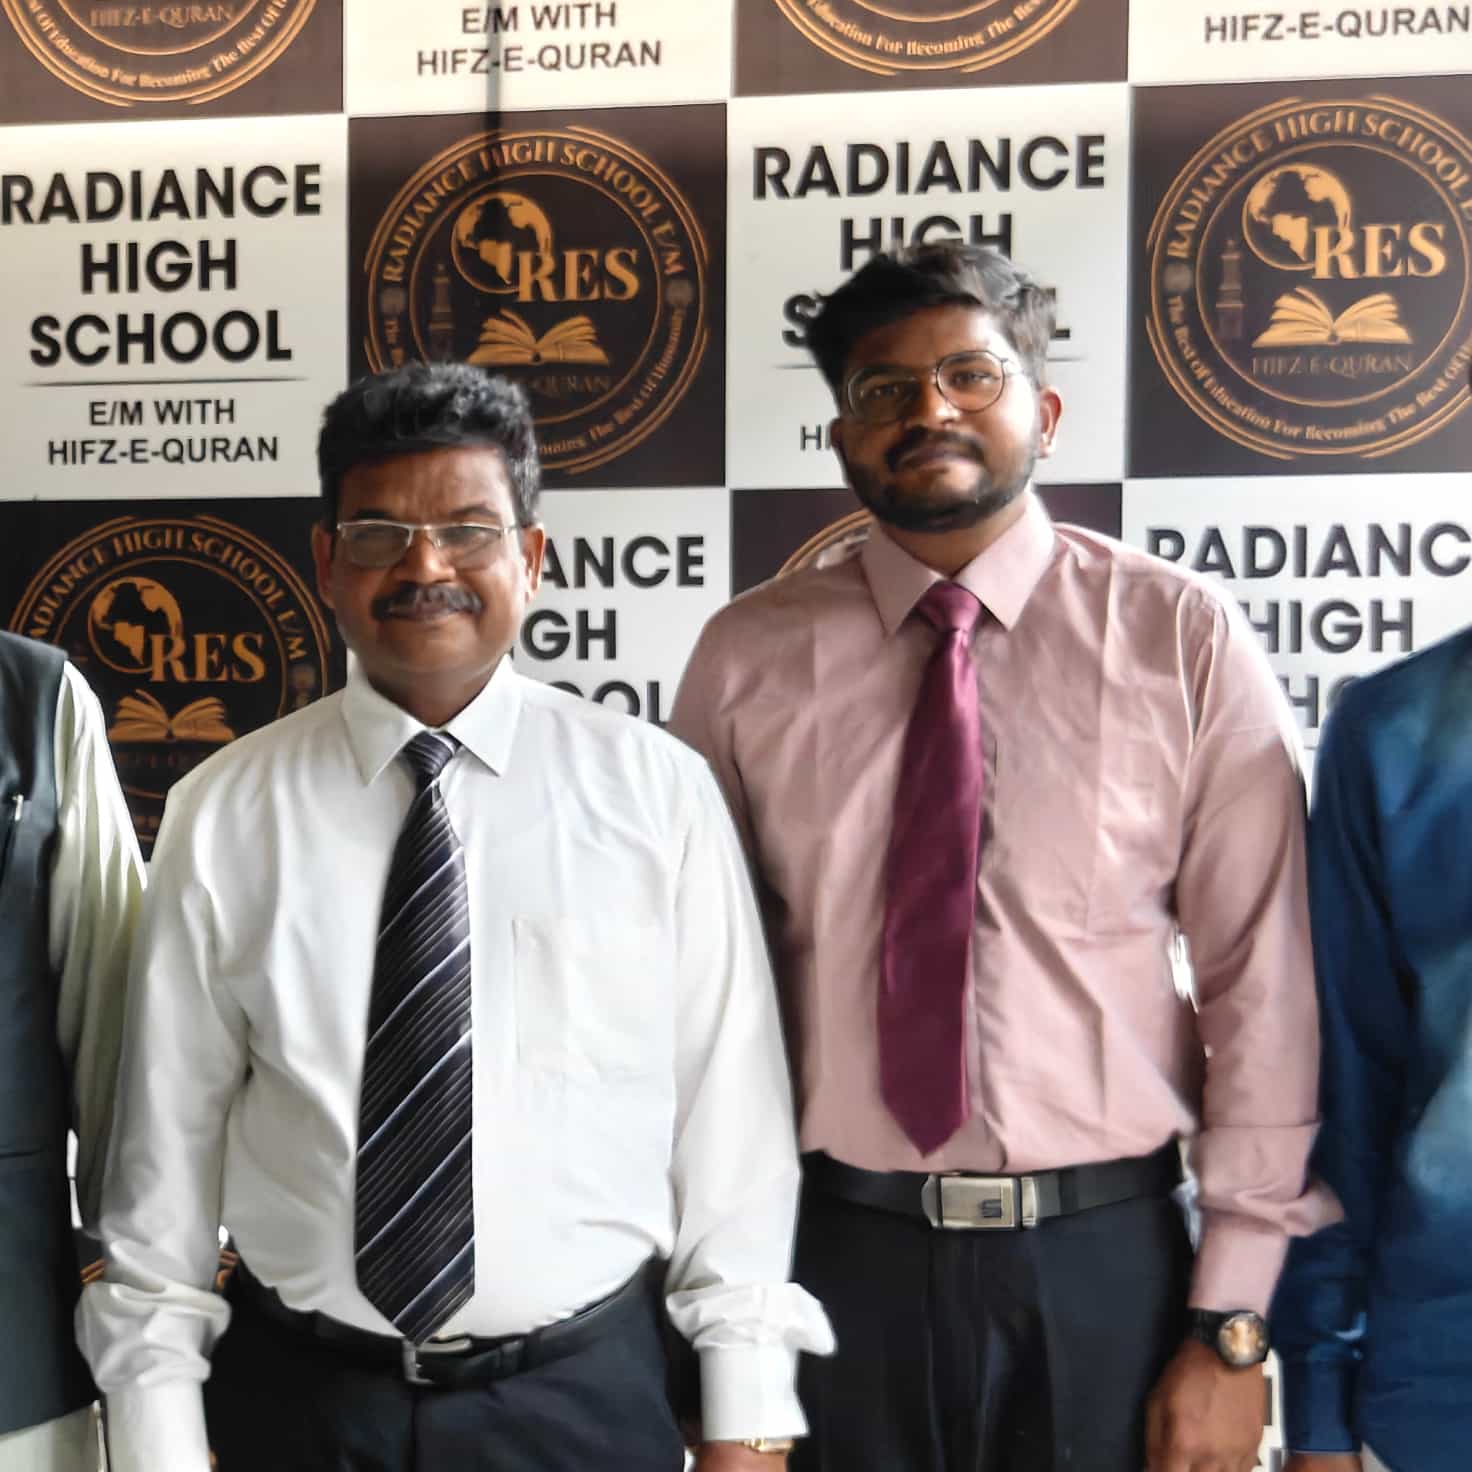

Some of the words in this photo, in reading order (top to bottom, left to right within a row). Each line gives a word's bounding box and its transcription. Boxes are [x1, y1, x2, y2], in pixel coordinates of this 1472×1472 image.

[463, 3, 517, 35] E/M
[531, 2, 616, 30] WITH
[1205, 6, 1469, 42] HIFZ-E-QURAN
[418, 40, 661, 77] HIFZ-E-QURAN
[2, 164, 320, 224] RADIANCE
[753, 135, 1105, 199] RADIANCE
[1165, 128, 1271, 259] RADIANCE
[1271, 111, 1355, 141] HIGH
[82, 239, 236, 294] HIGH
[514, 248, 639, 303] RES
[1310, 222, 1446, 280] RES
[30, 310, 292, 366] SCHOOL
[90, 401, 143, 425] E/M
[154, 399, 234, 424] WITH
[49, 437, 277, 464] HIFZ-E-QURAN
[544, 535, 704, 589] ANCE
[520, 609, 616, 661] GH
[1240, 599, 1414, 654] HIGH
[147, 632, 265, 682] RES
